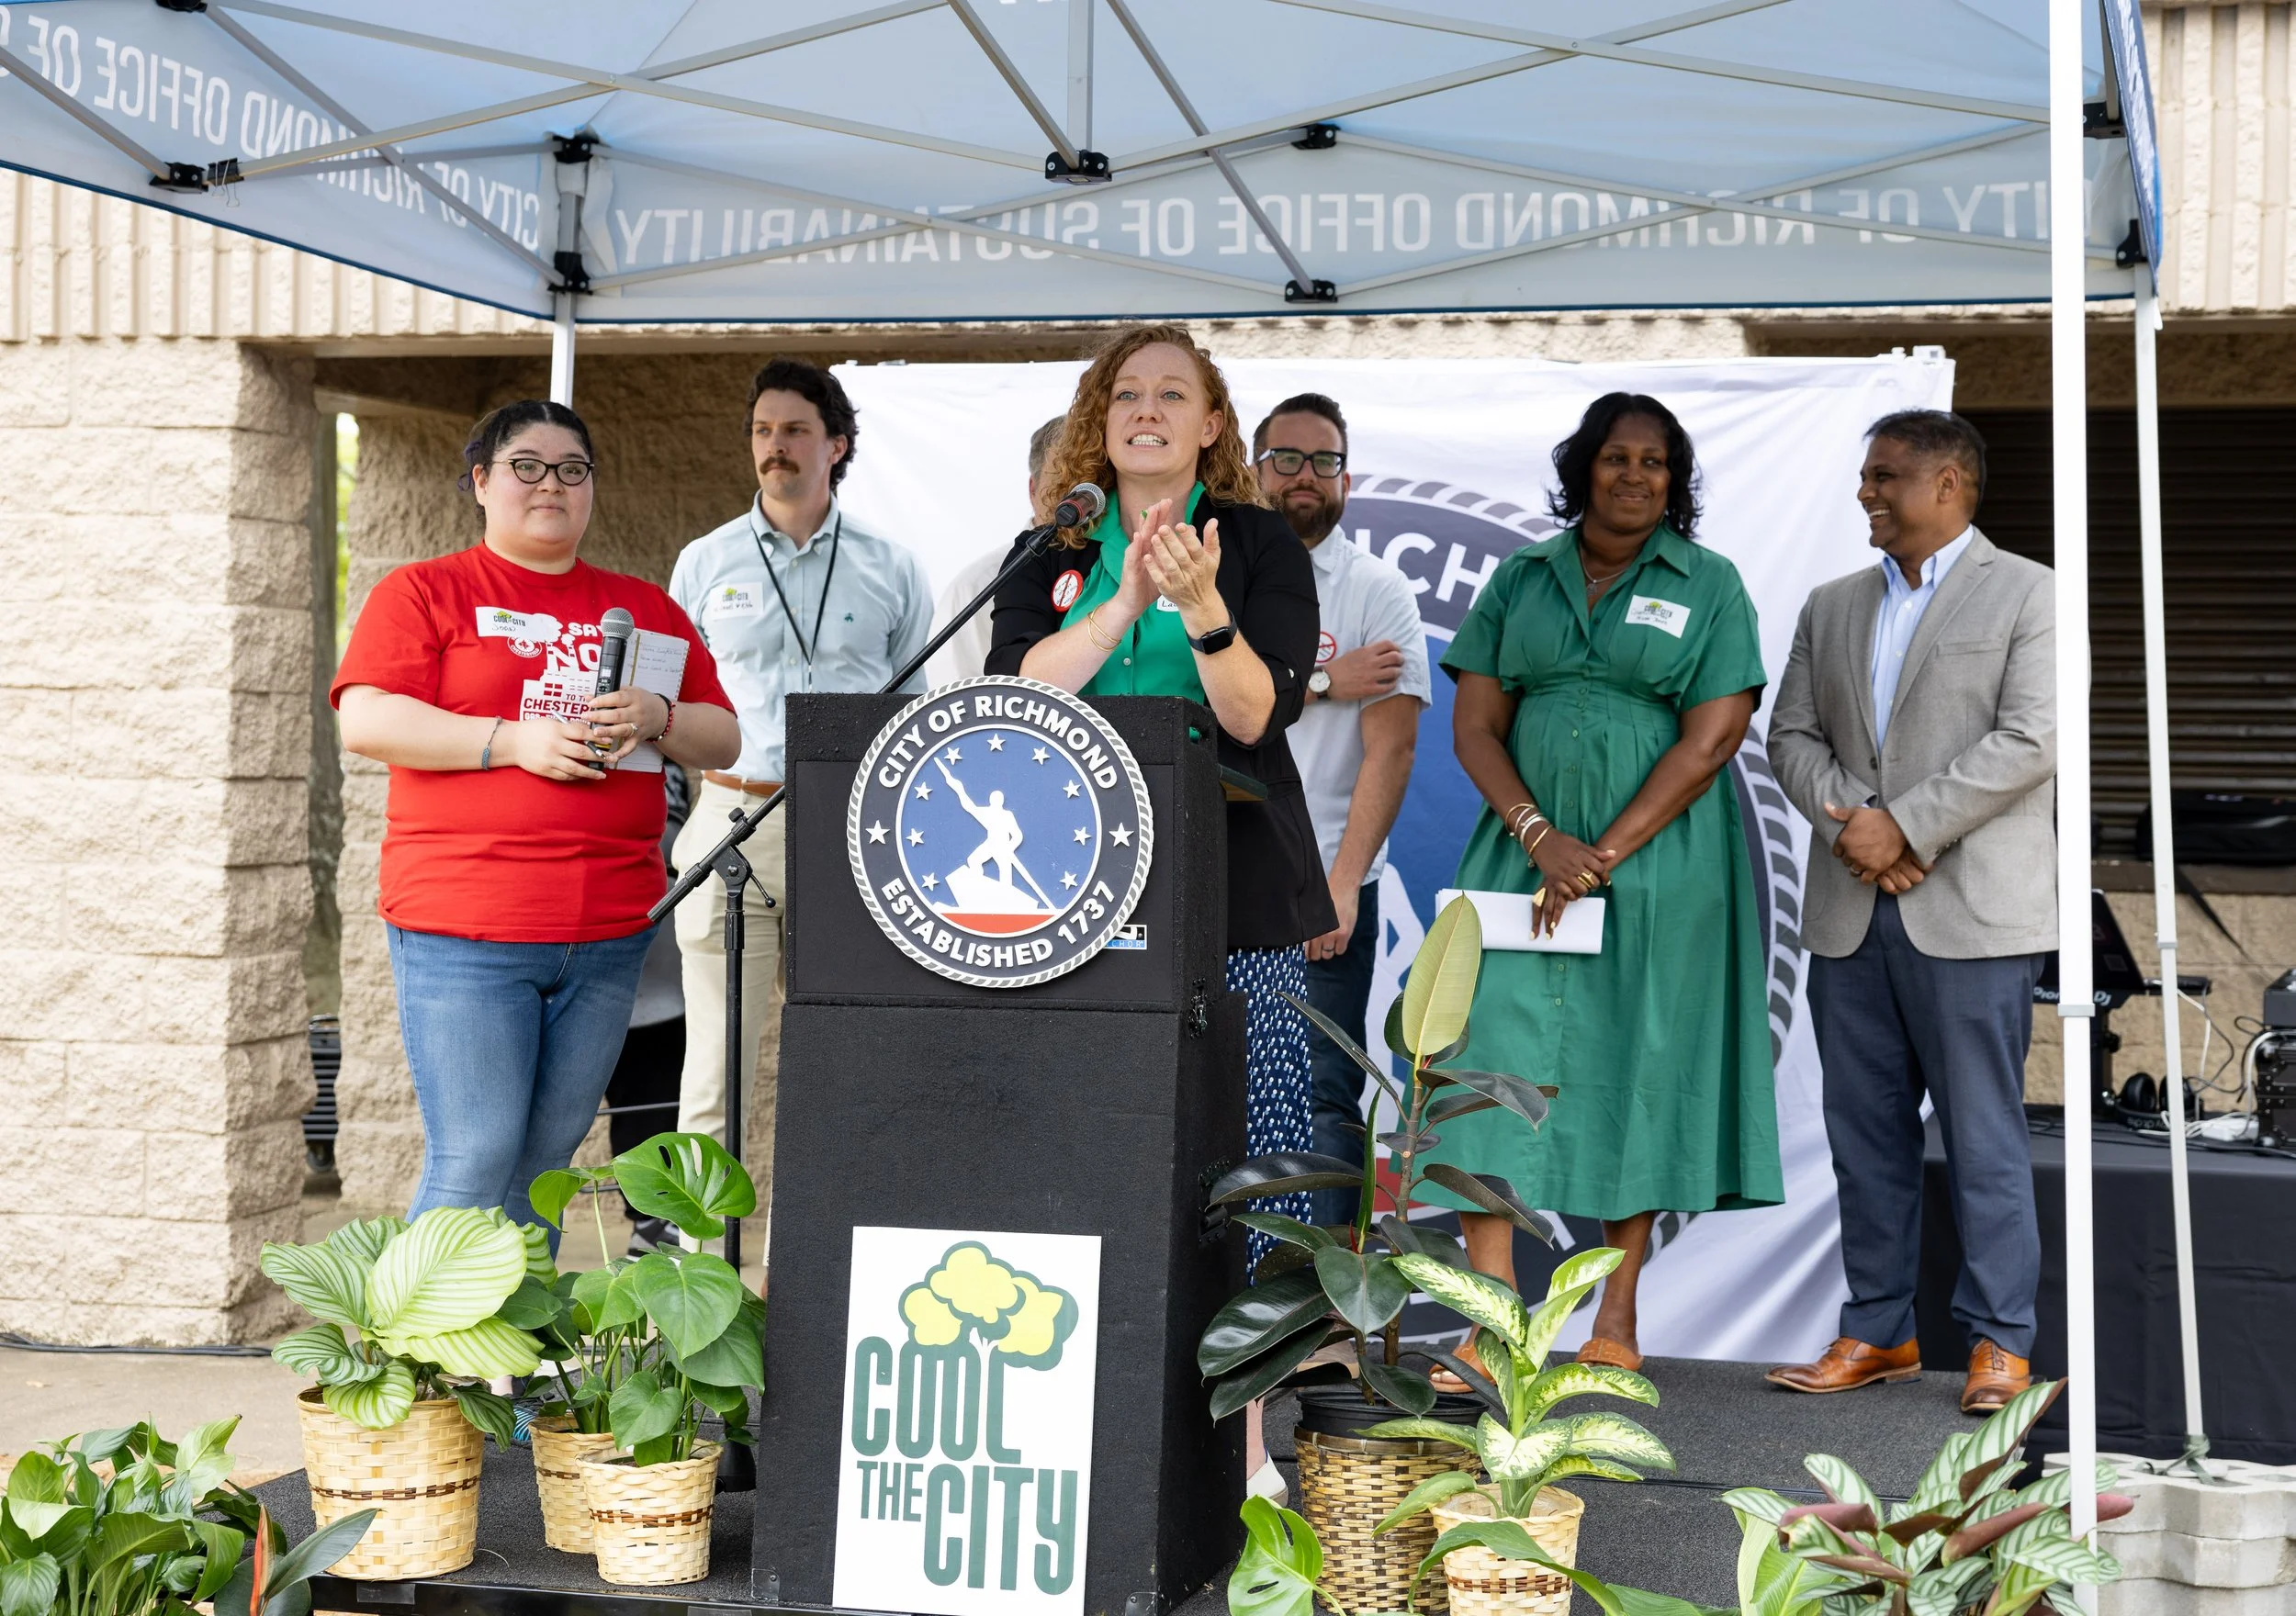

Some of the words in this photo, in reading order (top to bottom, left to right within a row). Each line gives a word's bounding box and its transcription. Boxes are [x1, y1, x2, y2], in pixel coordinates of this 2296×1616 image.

[568, 623, 602, 637] SA
[879, 725, 926, 789] CITY
[928, 701, 967, 733] OF
[974, 695, 1118, 790] RICHMOND
[881, 877, 1053, 968] ESTABLISHED
[1057, 880, 1115, 944] 1737
[851, 1336, 1021, 1464] COOL
[857, 1460, 924, 1521] THE
[923, 1464, 1078, 1596] CITY
